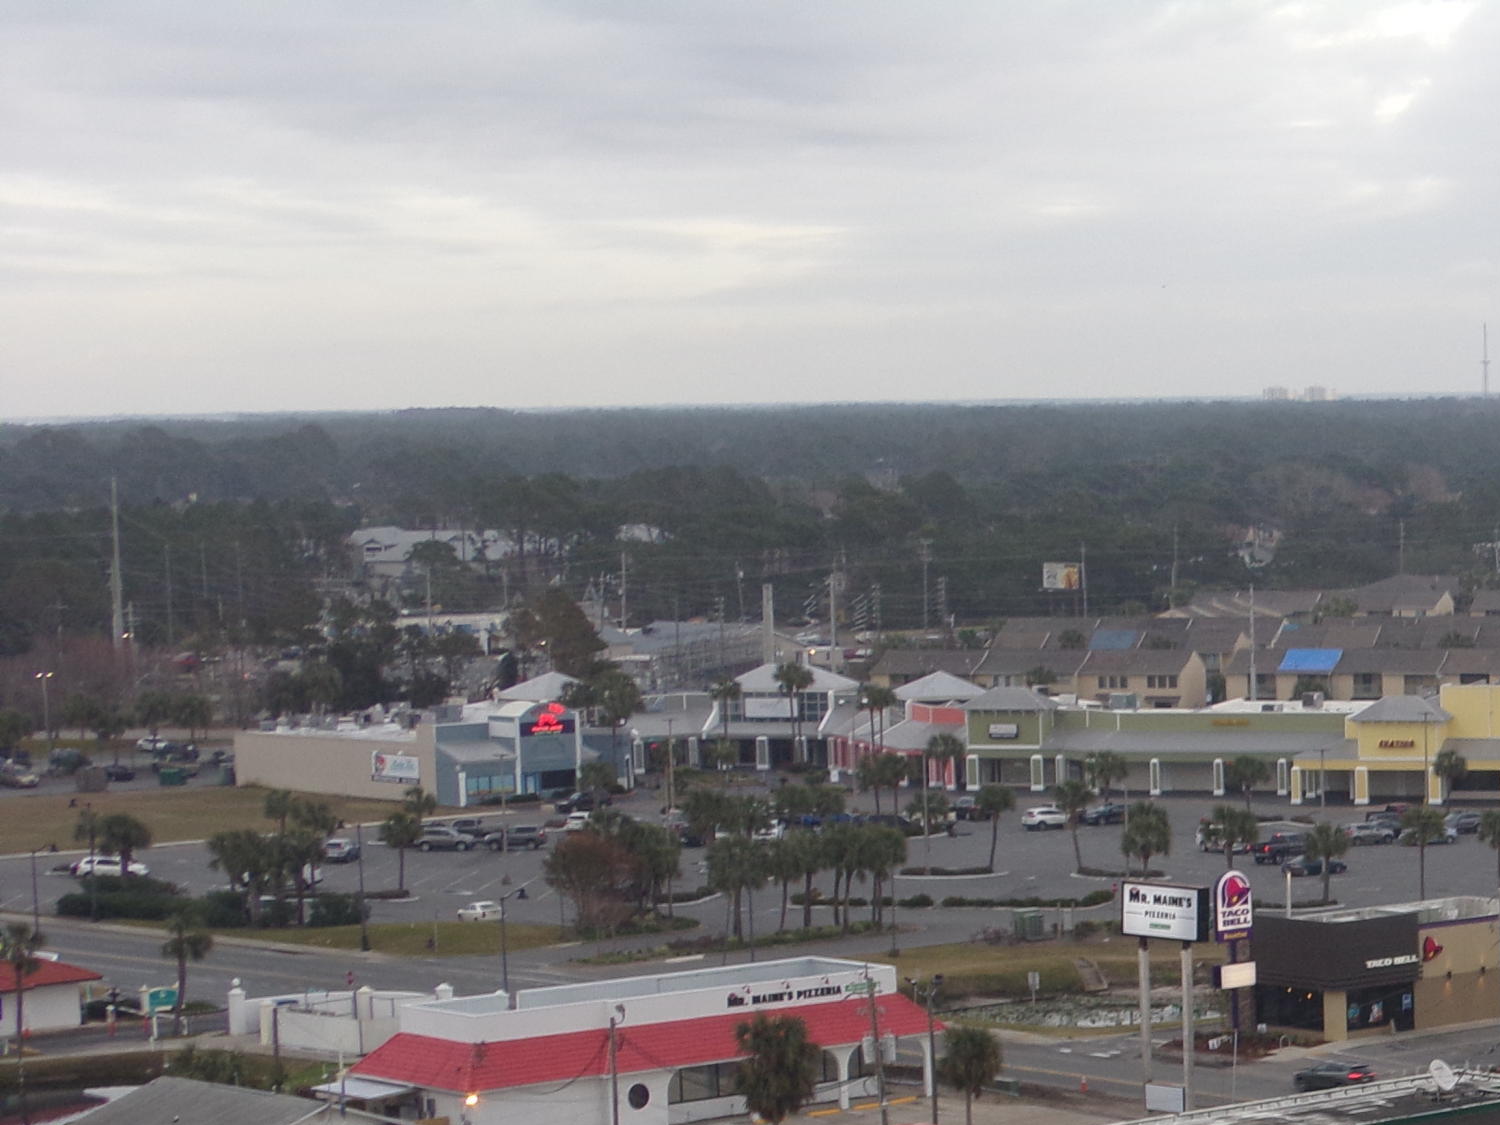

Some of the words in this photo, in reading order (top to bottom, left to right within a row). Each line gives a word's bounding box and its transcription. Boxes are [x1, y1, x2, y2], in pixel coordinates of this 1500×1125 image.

[1220, 908, 1250, 919] TACO
[1222, 918, 1251, 928] BELL
[1394, 954, 1420, 966] BELL
[752, 990, 793, 1005] MAINE'S
[796, 985, 842, 1000] PIZZERIA
